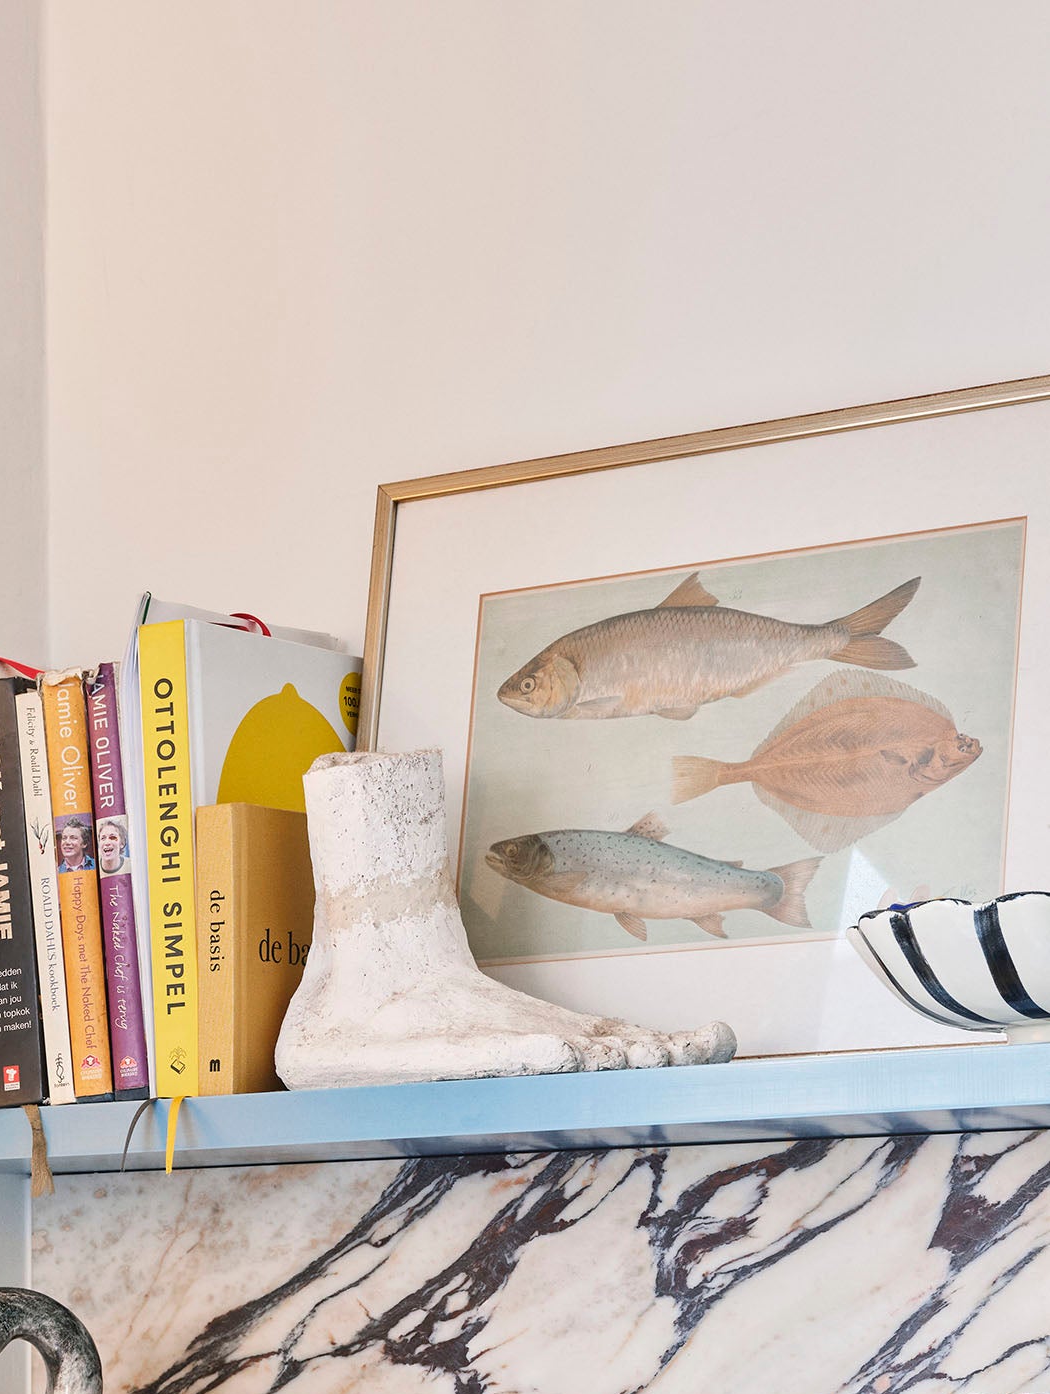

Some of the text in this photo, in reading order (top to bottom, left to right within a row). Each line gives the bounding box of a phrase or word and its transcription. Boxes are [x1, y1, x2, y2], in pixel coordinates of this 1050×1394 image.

[26, 707, 35, 737] Felicity
[29, 748, 40, 775] Roald
[95, 736, 115, 809] OLIVER
[32, 775, 43, 798] Dahl
[61, 745, 84, 810] Oliver
[154, 678, 186, 1015] OTTOLENGHI SIMPEL
[109, 885, 119, 908] The
[41, 877, 52, 919] ROALD
[48, 962, 61, 1012] kookboek
[111, 911, 122, 951] Naked
[209, 889, 225, 972] de basis
[72, 876, 98, 1050] Happy Days met The Naked Chef
[258, 928, 311, 967] de ba
[9, 995, 22, 1005] jou
[10, 981, 18, 990] ik
[116, 984, 125, 995] is
[3, 1007, 31, 1019] topkok
[3, 1020, 32, 1032] maken!
[115, 998, 128, 1031] terug
